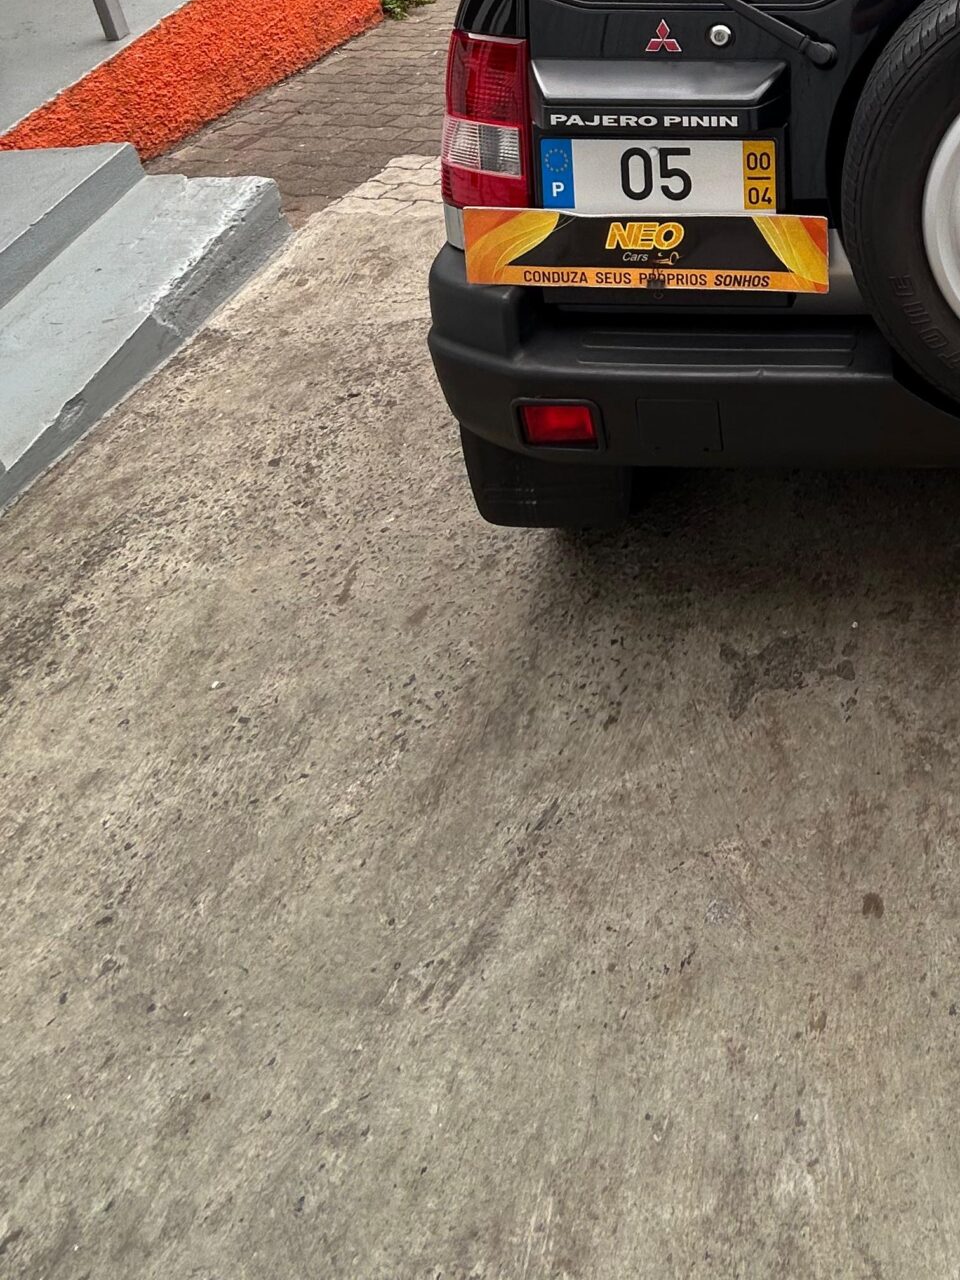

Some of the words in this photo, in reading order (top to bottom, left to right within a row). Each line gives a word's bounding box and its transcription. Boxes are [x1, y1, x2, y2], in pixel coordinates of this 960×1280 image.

[550, 113, 658, 127] PAJERO
[664, 114, 739, 128] PININ
[746, 152, 771, 171] 00
[620, 147, 693, 201] 05
[552, 182, 565, 197] P
[748, 187, 772, 205] 04
[605, 221, 685, 250] NEO
[622, 251, 648, 262] Cars
[523, 269, 588, 285] CONDUZA
[595, 271, 632, 285] SEUS
[639, 270, 707, 286] PRÓPRIOS
[714, 274, 770, 287] SONHOS
